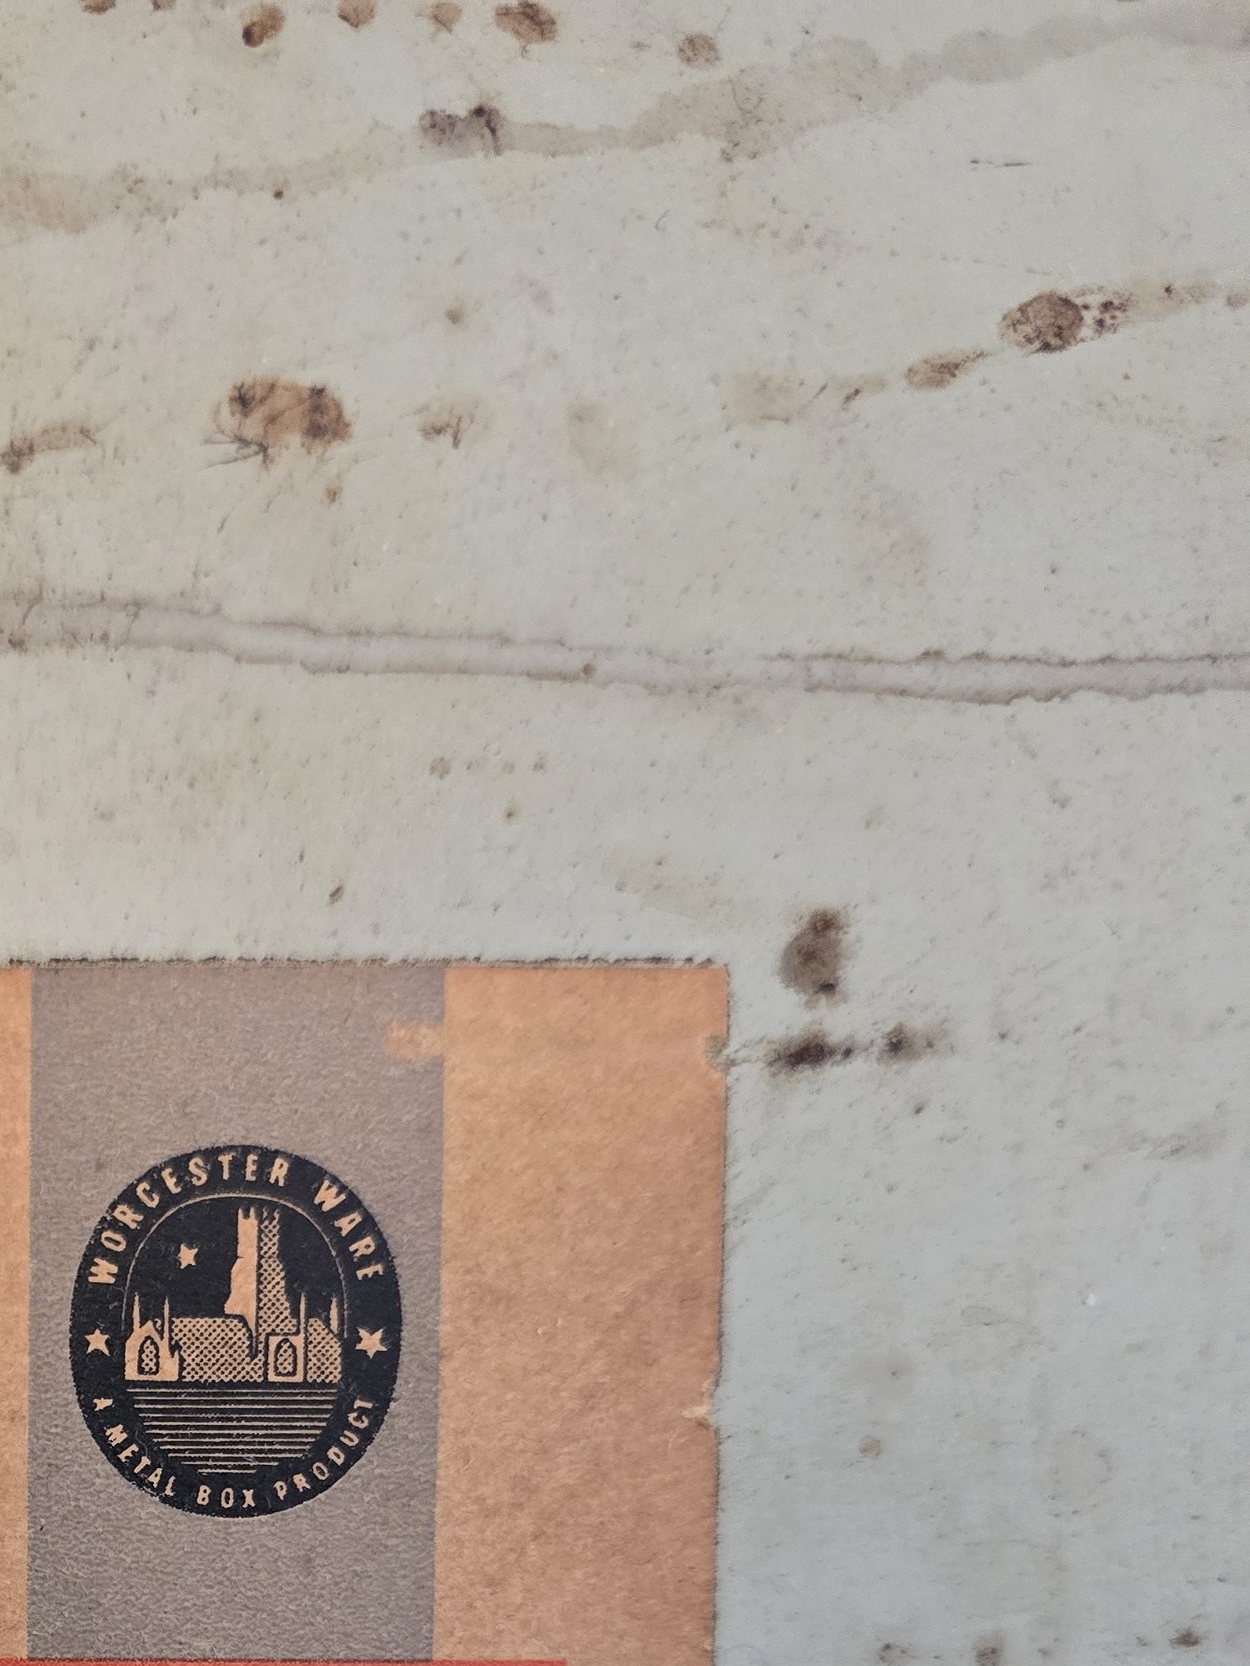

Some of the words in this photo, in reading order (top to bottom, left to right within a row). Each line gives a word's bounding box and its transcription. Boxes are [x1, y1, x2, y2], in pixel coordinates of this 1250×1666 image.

[86, 1153, 290, 1285] WORCESTER
[312, 1178, 385, 1282] WARE
[104, 1423, 178, 1498] METAL
[195, 1484, 257, 1509] BOX
[271, 1398, 374, 1500] PRODUCT
